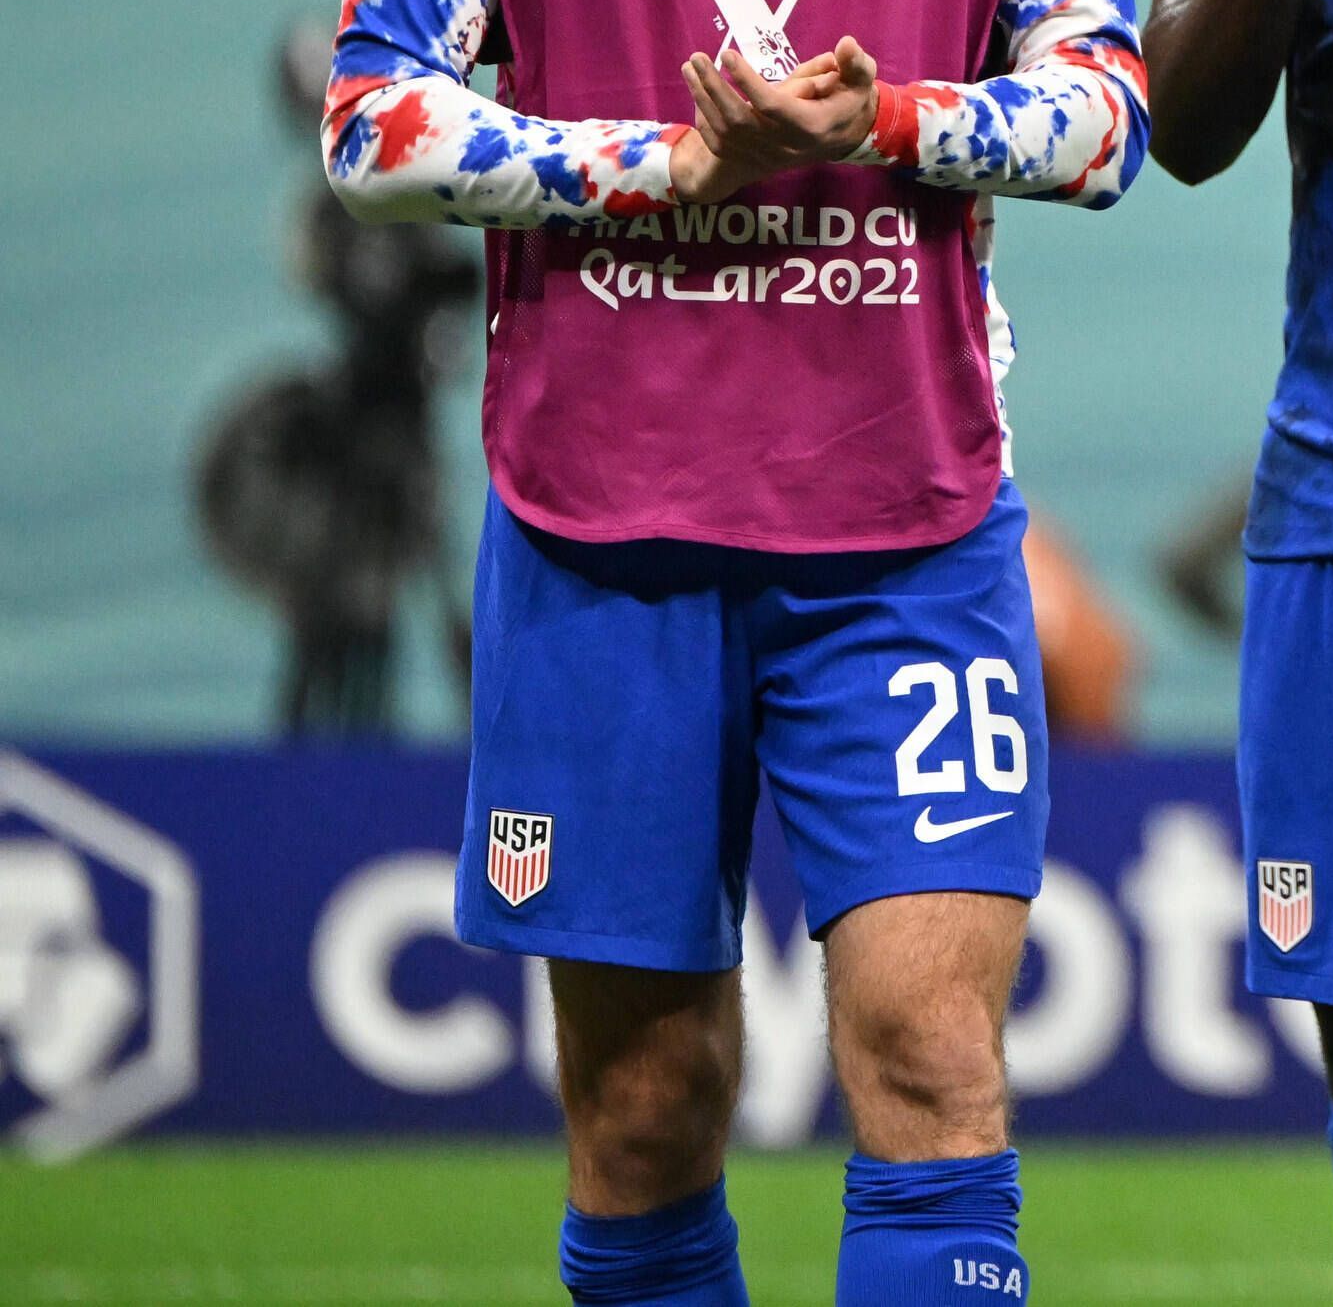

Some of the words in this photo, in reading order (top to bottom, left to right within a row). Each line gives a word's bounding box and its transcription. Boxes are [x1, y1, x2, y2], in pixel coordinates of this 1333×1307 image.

[672, 205, 856, 246] WORLD
[864, 207, 918, 247] CU
[888, 658, 1028, 797] 26
[494, 816, 547, 852] USA
[1263, 867, 1306, 899] USA
[954, 1259, 1021, 1298] USA
